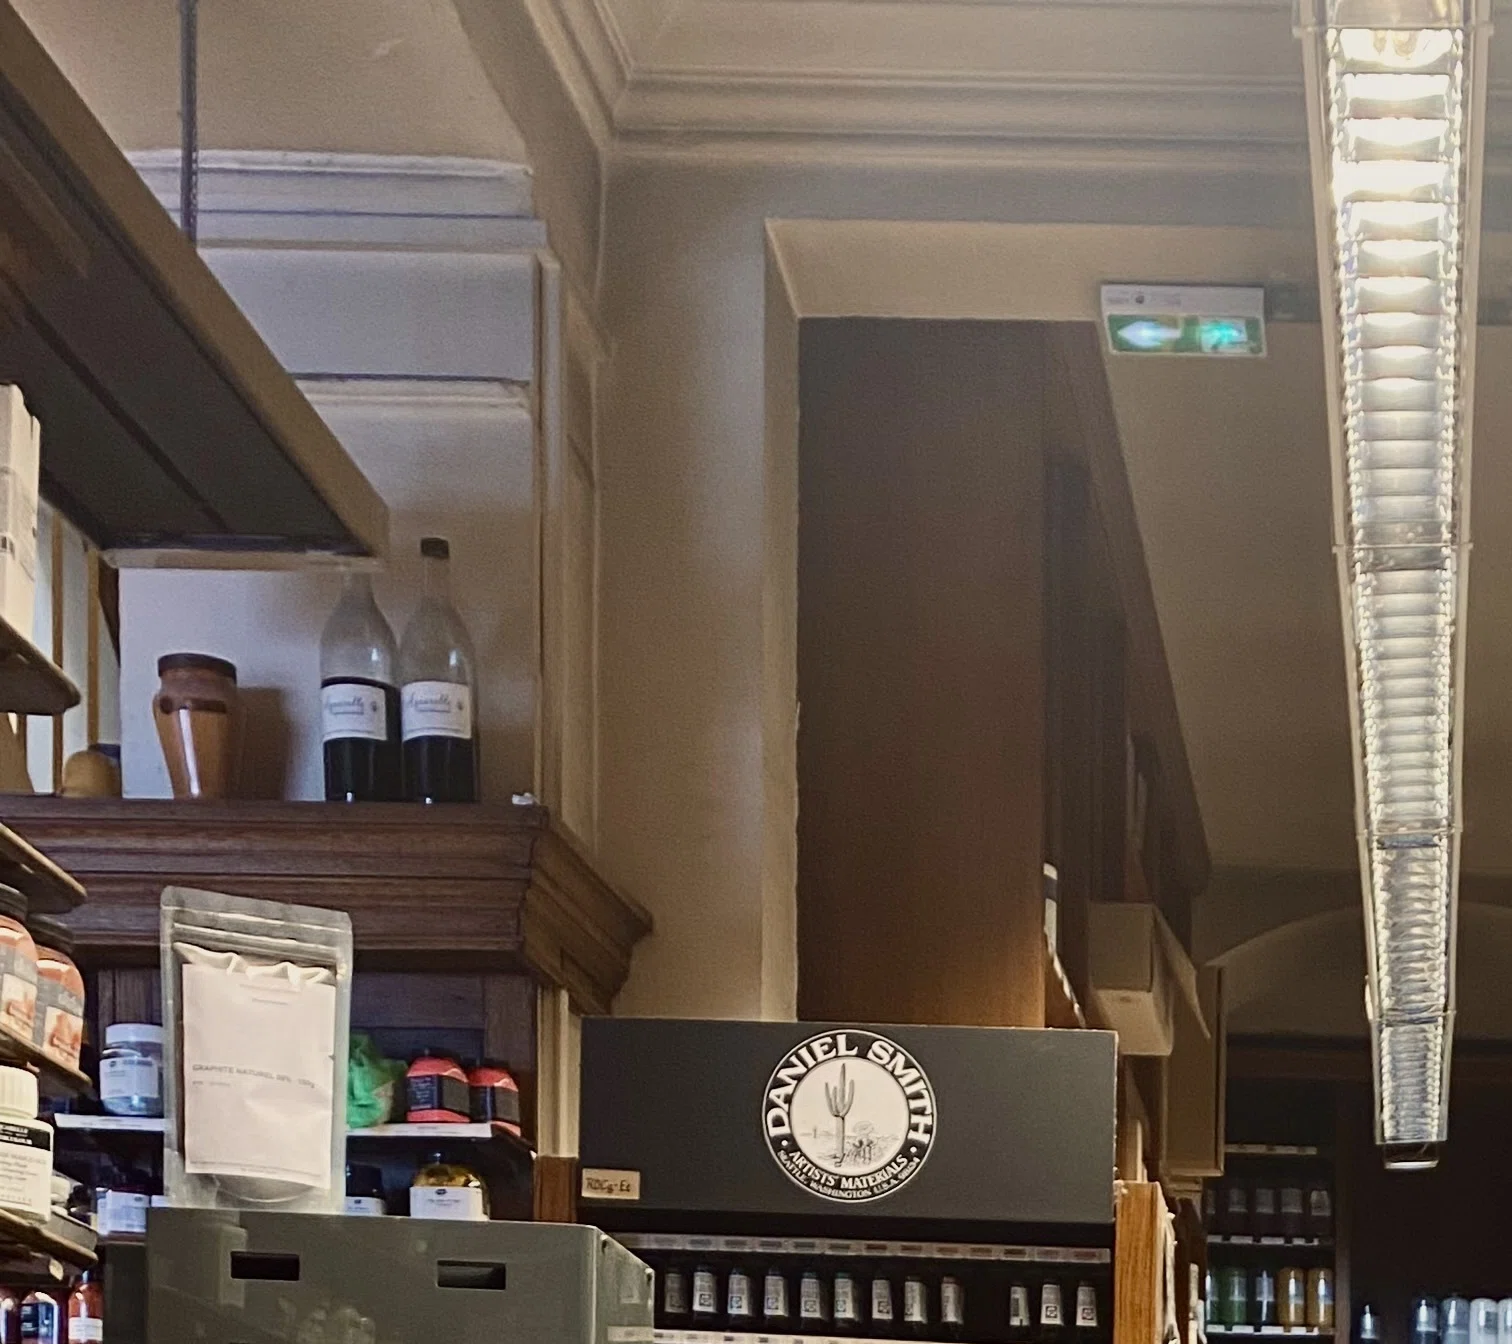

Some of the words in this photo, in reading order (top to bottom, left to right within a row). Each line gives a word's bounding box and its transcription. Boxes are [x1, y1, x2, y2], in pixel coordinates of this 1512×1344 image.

[766, 1033, 859, 1138] DANIEL
[866, 1039, 934, 1145] SMITH
[840, 1154, 909, 1190] MATERIALS
